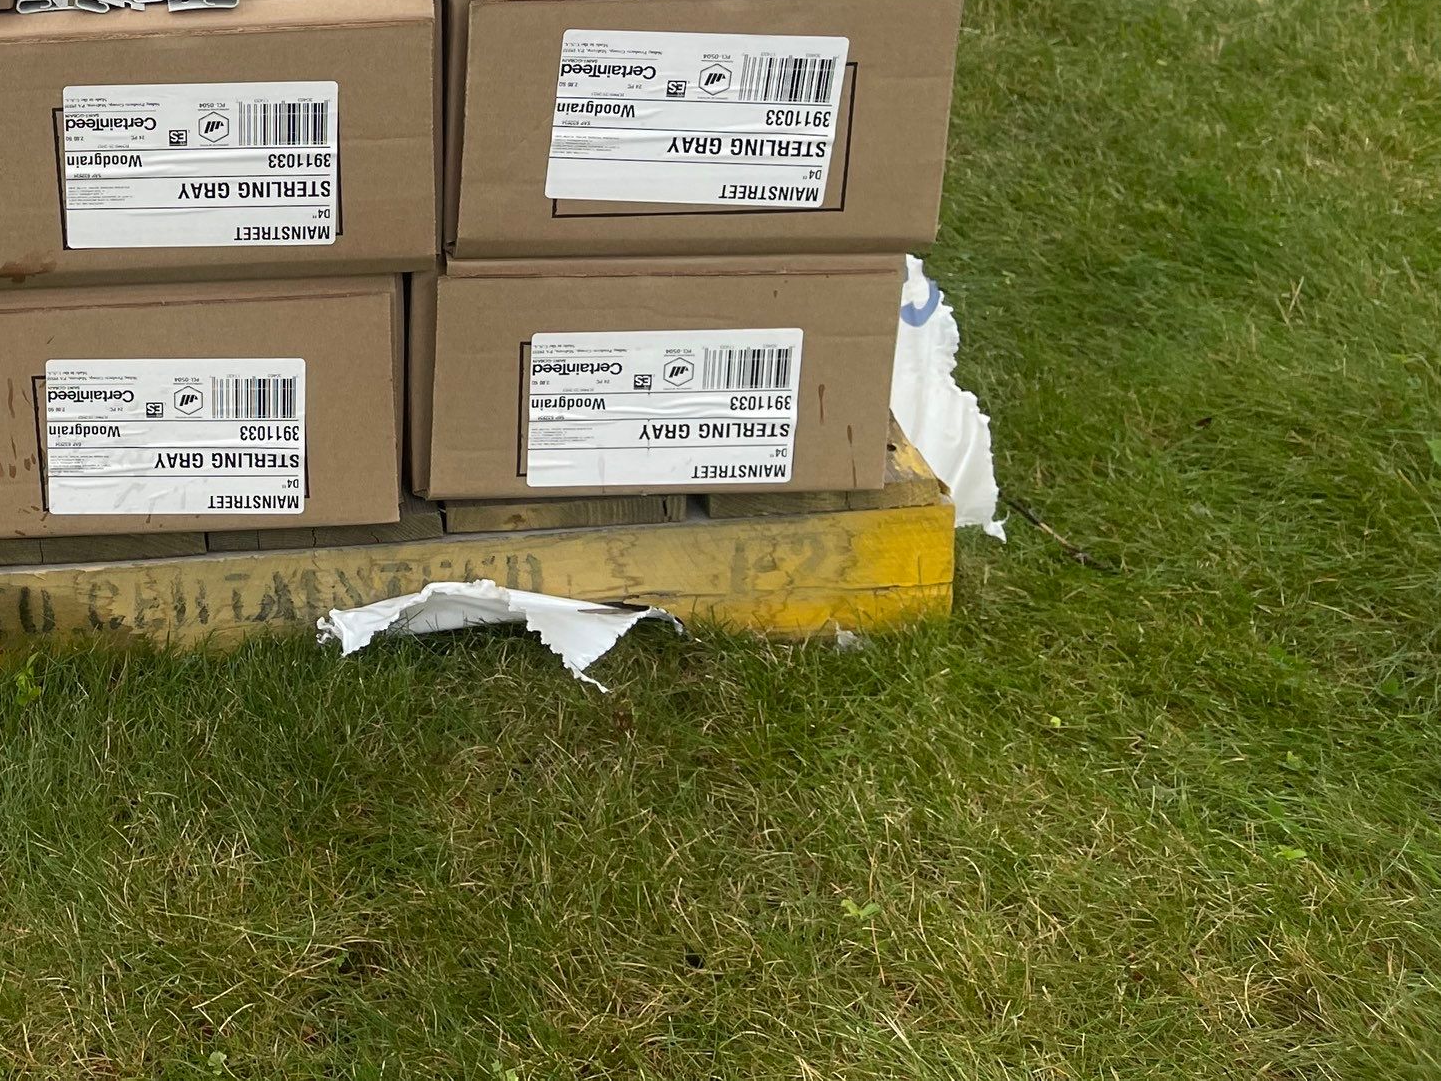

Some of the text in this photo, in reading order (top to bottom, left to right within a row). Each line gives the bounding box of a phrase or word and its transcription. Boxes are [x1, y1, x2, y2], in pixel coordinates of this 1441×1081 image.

[561, 64, 656, 79] CertainTeed
[668, 82, 685, 94] ES
[557, 101, 634, 117] Woodgrain
[66, 118, 156, 131] CertainTeed
[766, 110, 831, 127] 3911033
[170, 131, 186, 142] ES
[667, 137, 826, 157] STERLING GRAY
[67, 153, 142, 168] Woodgrain
[268, 154, 331, 168] 3911033
[803, 170, 822, 181] D4"
[178, 181, 330, 199] STERLING GRAY
[719, 185, 818, 201] MAINSTREET
[313, 209, 330, 219] D4"
[234, 226, 329, 240] MAINSTREET
[533, 363, 622, 375] CertainTeed
[635, 376, 650, 386] ES
[48, 390, 134, 402] CertainTeed
[147, 404, 162, 414] ES
[531, 398, 605, 410] Woodgrain
[730, 396, 791, 410] 3911033
[49, 424, 120, 437] Woodgrain
[240, 426, 299, 441] 3911033
[639, 423, 790, 440] STERLING GRAY
[770, 448, 787, 457] D4"
[155, 453, 299, 468] STERLING GRAY
[692, 465, 785, 478] MAINSTREET
[282, 478, 299, 487] D4"
[208, 496, 298, 508] MAINSTREET
